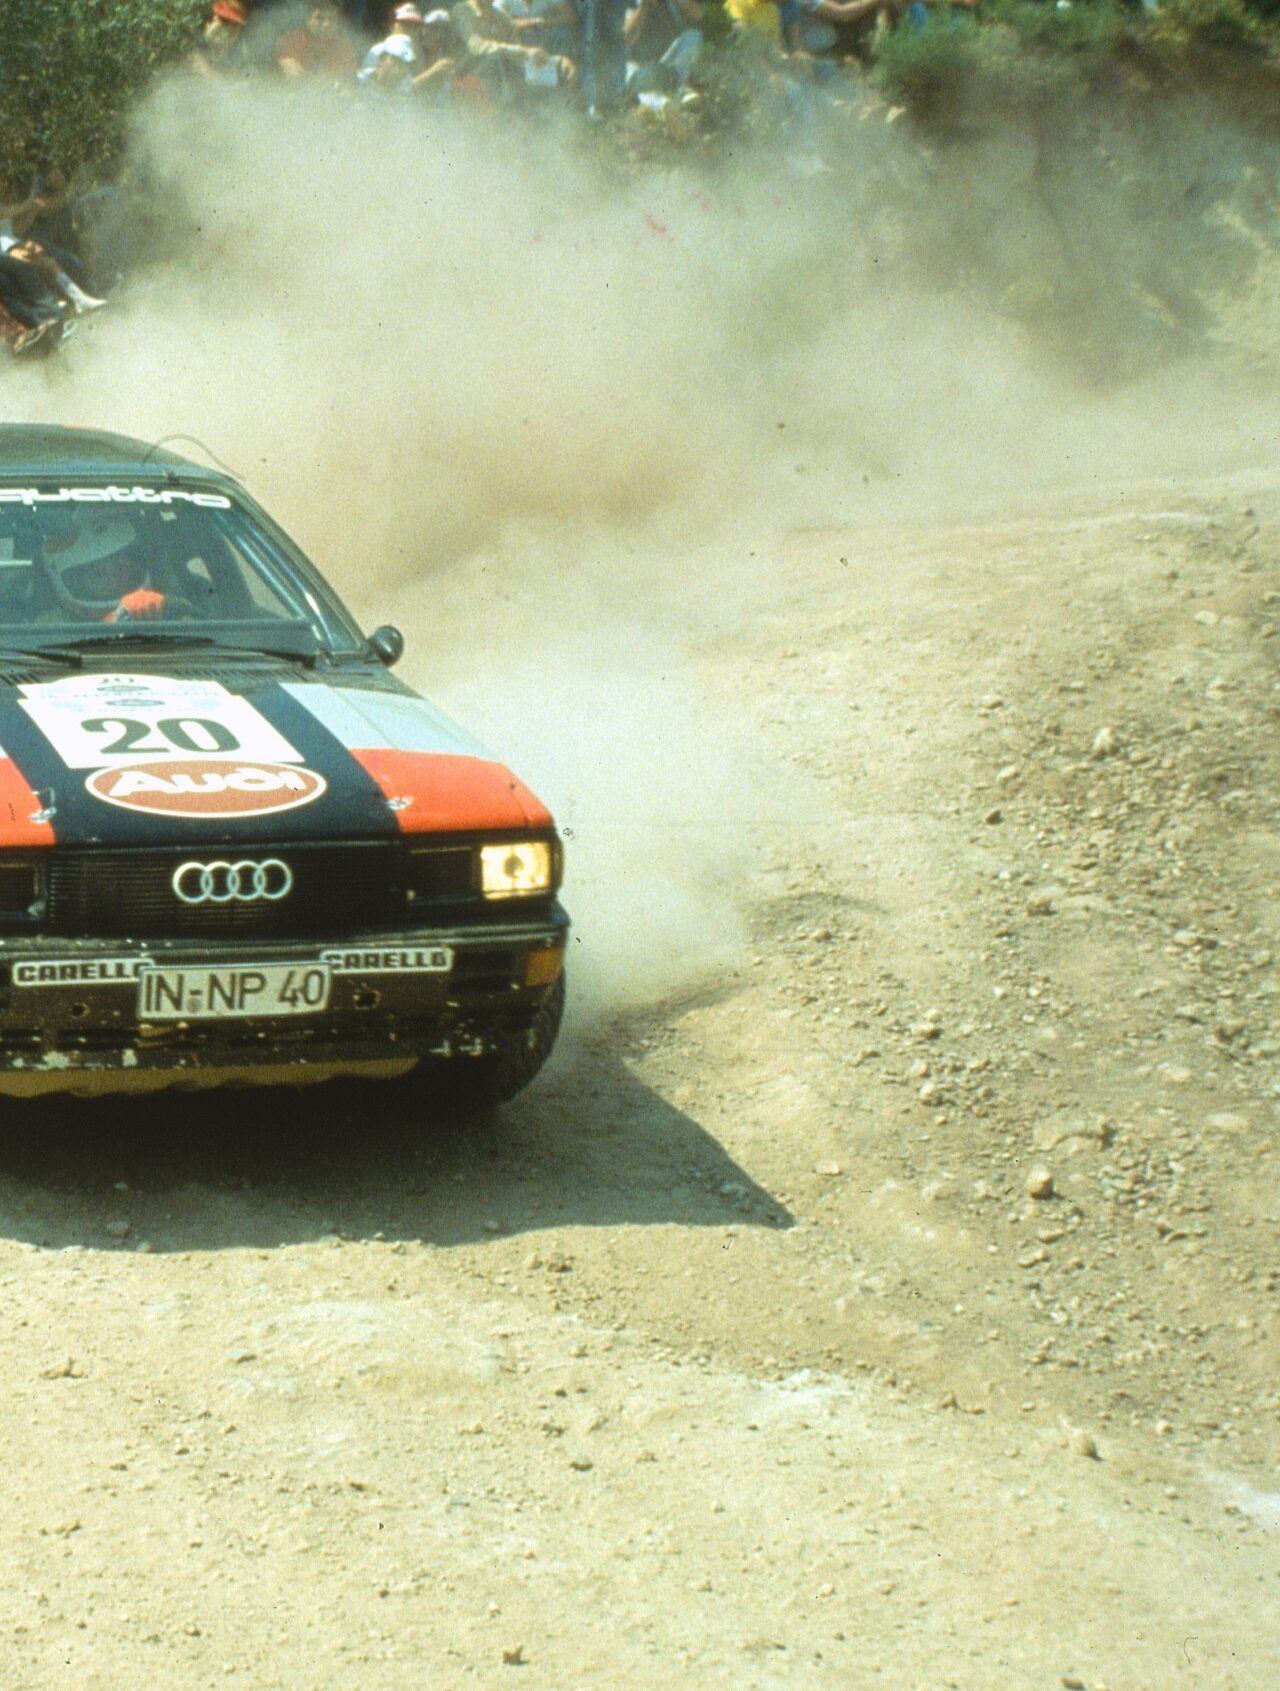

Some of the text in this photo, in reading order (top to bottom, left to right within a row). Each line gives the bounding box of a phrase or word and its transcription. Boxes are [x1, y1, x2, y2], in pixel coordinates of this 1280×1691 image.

[80, 717, 241, 755] 20
[109, 767, 306, 797] Audi
[145, 969, 324, 1013] IN-NP 40
